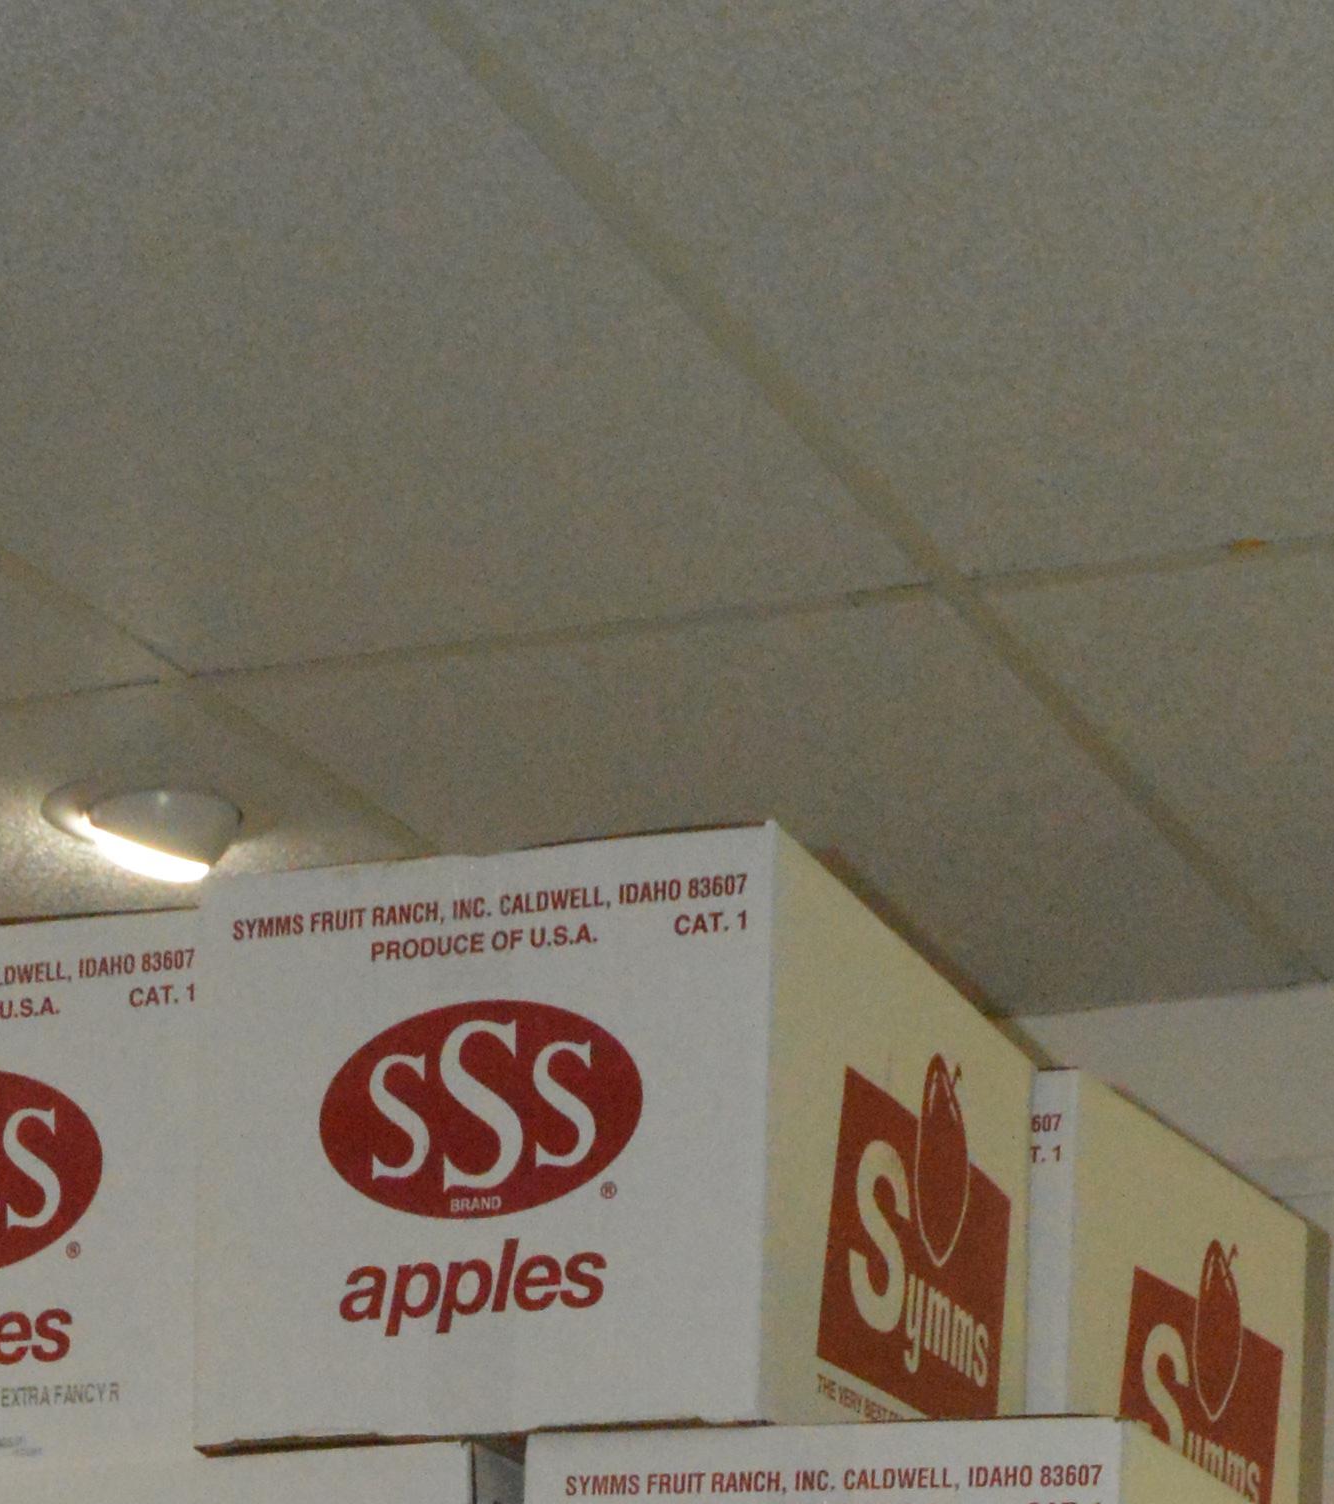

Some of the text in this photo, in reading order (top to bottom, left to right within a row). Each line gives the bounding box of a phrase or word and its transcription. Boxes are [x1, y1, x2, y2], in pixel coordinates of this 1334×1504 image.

[232, 873, 748, 942] SYMMS FRUIT RANCH, INC. CALDWELL, IDAHO 83607
[673, 910, 747, 936] CAT. 1
[370, 922, 598, 962] PRODUCE OF U.S.A.
[78, 953, 137, 978] IDAHO
[140, 947, 196, 973] 83607
[129, 982, 196, 1009] CAT. 1
[369, 1020, 596, 1193] SSS
[449, 1196, 502, 1213] BRAND
[848, 1139, 989, 1387] Symms
[339, 1238, 607, 1336] apples
[565, 1464, 1102, 1497] SYMMS FRUIT RANCH, INC. CALDWELL, IDAHO 83607
